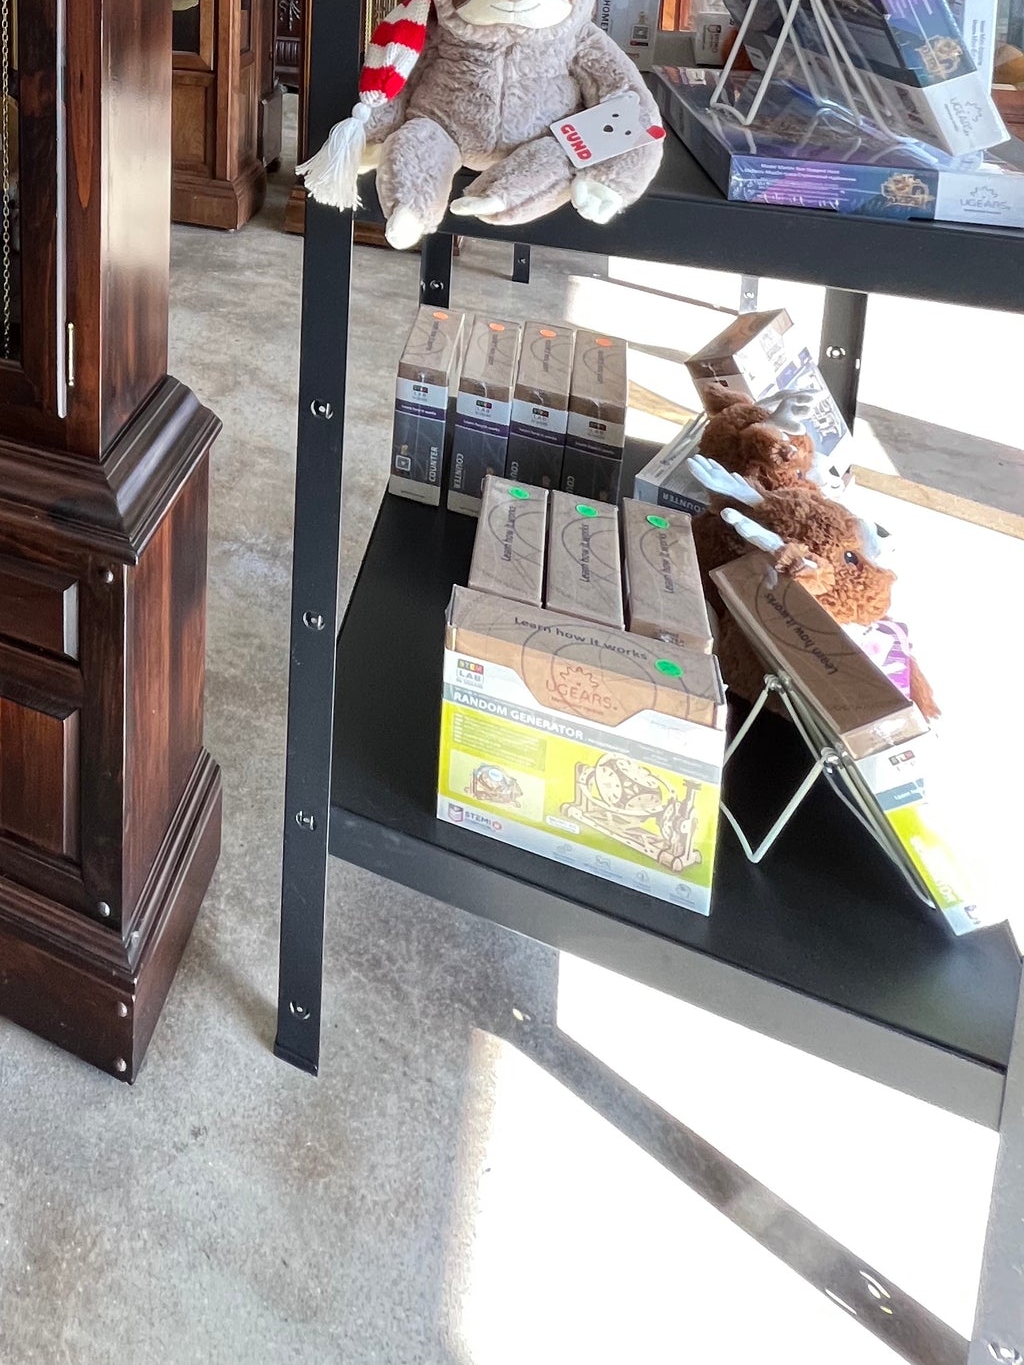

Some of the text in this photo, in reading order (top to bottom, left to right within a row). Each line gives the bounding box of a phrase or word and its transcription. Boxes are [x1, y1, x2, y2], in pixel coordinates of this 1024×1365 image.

[560, 124, 592, 161] GUND
[429, 446, 439, 482] COUNTER
[501, 544, 512, 561] Learn
[579, 564, 590, 582] Learn
[663, 574, 674, 593] Learn
[765, 593, 789, 619] works
[513, 616, 649, 661] Learn how it works
[794, 627, 816, 648] how
[458, 659, 484, 674] STEM
[812, 647, 838, 675] Learn
[459, 670, 482, 682] LAB
[546, 679, 612, 710] UGEARS
[453, 690, 508, 716] RANDOM
[510, 709, 584, 741] GENERATOR
